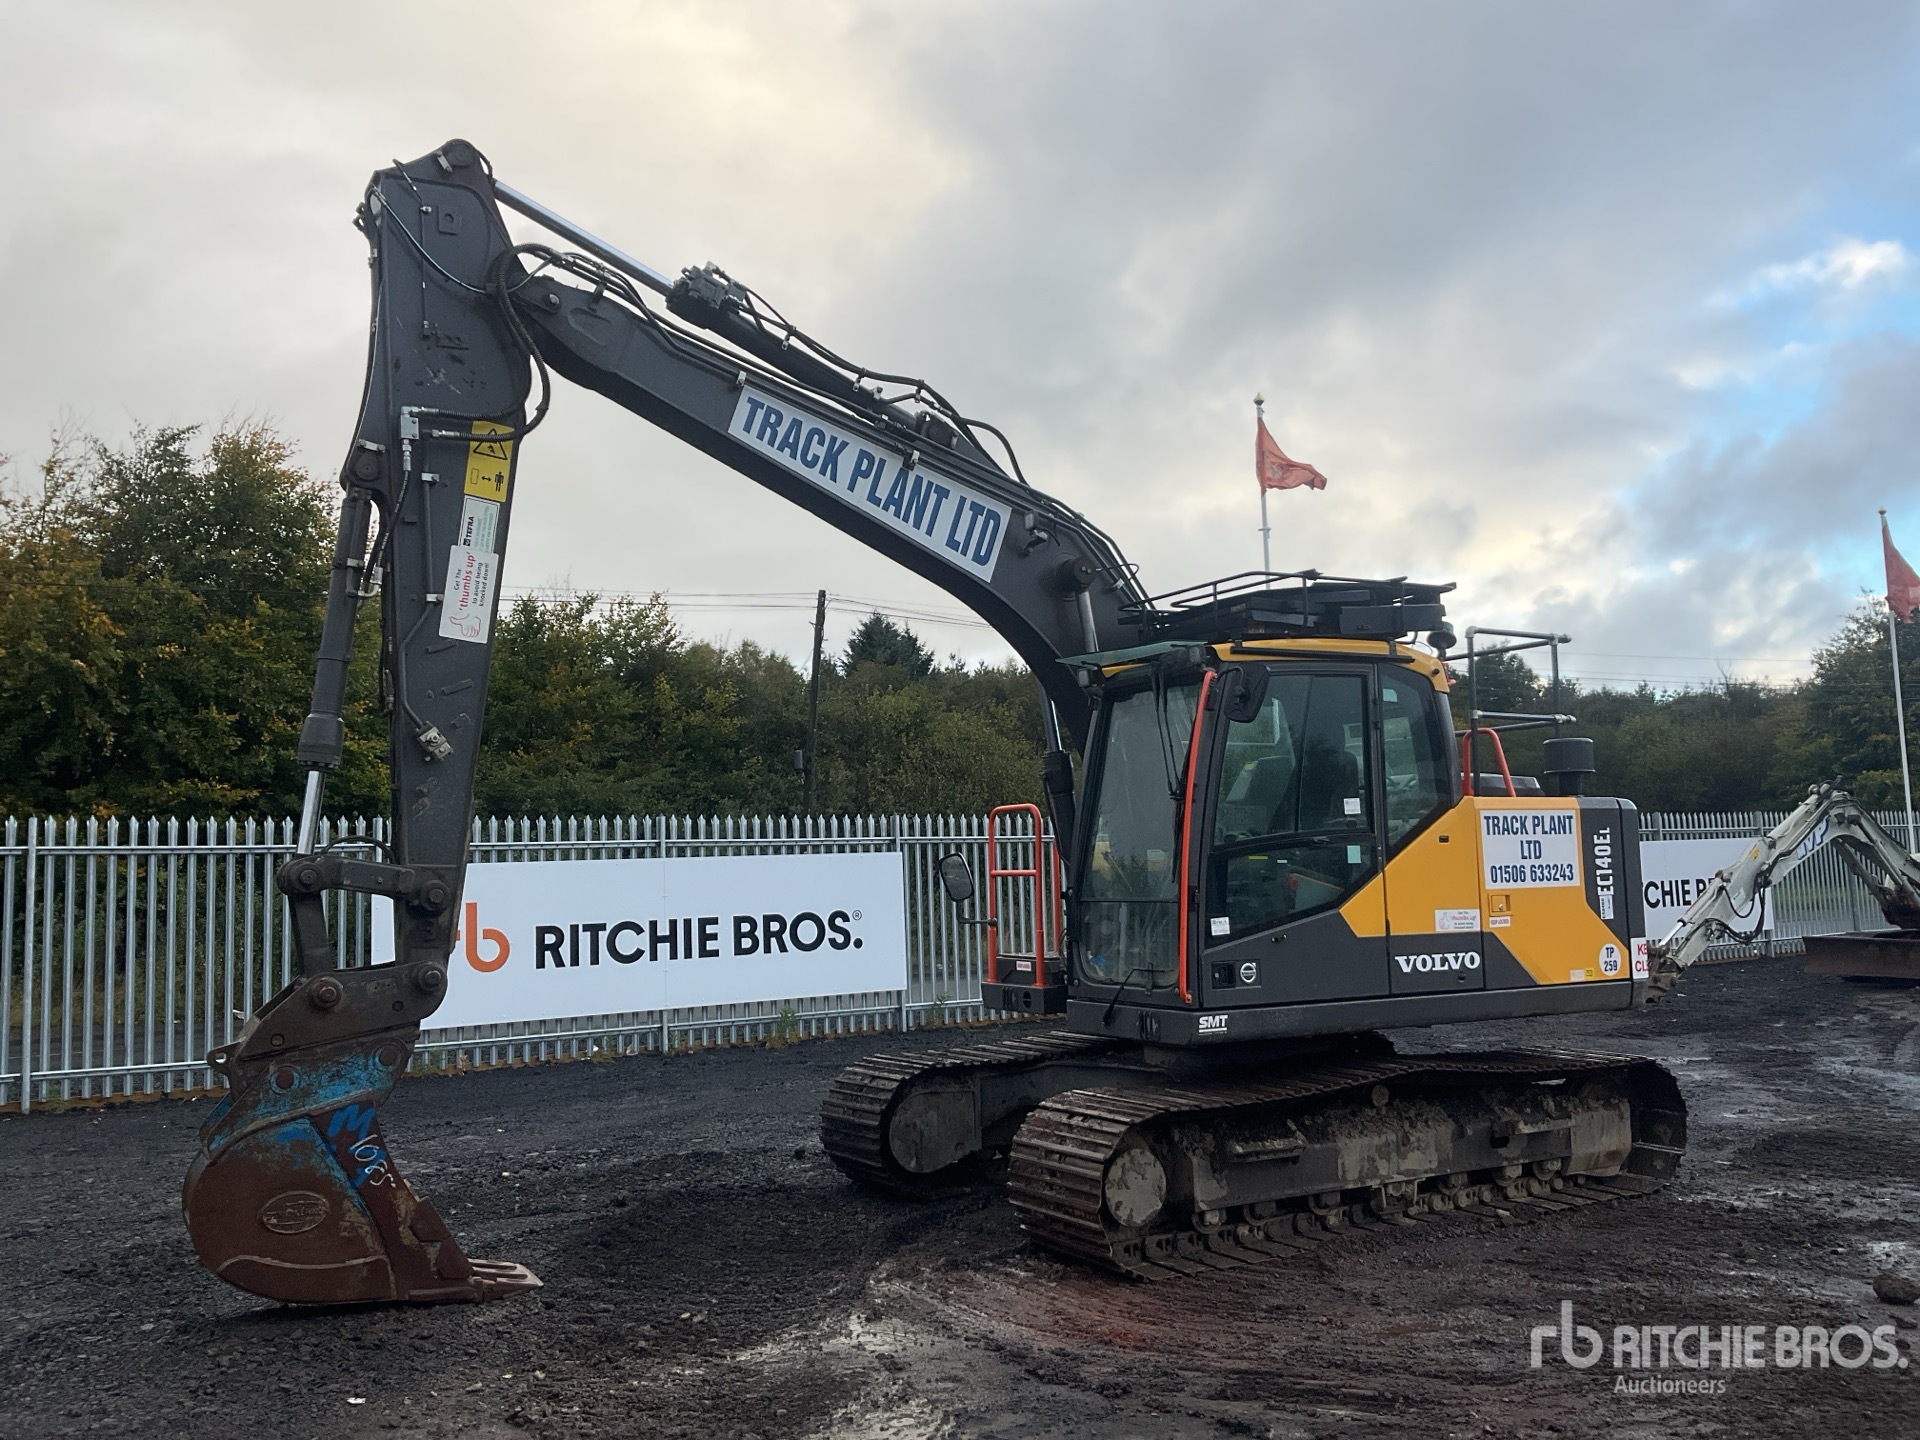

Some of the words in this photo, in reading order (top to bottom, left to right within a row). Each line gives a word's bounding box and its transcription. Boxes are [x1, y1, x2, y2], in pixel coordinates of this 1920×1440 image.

[742, 397, 849, 484] TRACK
[847, 448, 950, 538] PLANT
[945, 495, 1001, 567] LTD
[465, 516, 475, 538] TEFRA
[474, 562, 483, 579] being
[473, 580, 481, 597] avoid
[478, 582, 488, 607] knocked
[1483, 815, 1529, 836] TRACK
[1532, 815, 1574, 836] PLANT
[1520, 840, 1542, 860] LTD
[1593, 827, 1614, 896] EC140EL
[1490, 864, 1526, 884] 01506
[1530, 863, 1574, 883] 633243
[1643, 879, 1692, 909] CHIE
[535, 916, 720, 970] RITCHIE
[1605, 947, 1615, 958] TP
[1637, 943, 1648, 956] KE
[1395, 951, 1480, 973] VOLVO
[1604, 960, 1618, 972] 259
[1635, 960, 1649, 972] CL
[1198, 1014, 1228, 1029] SMT
